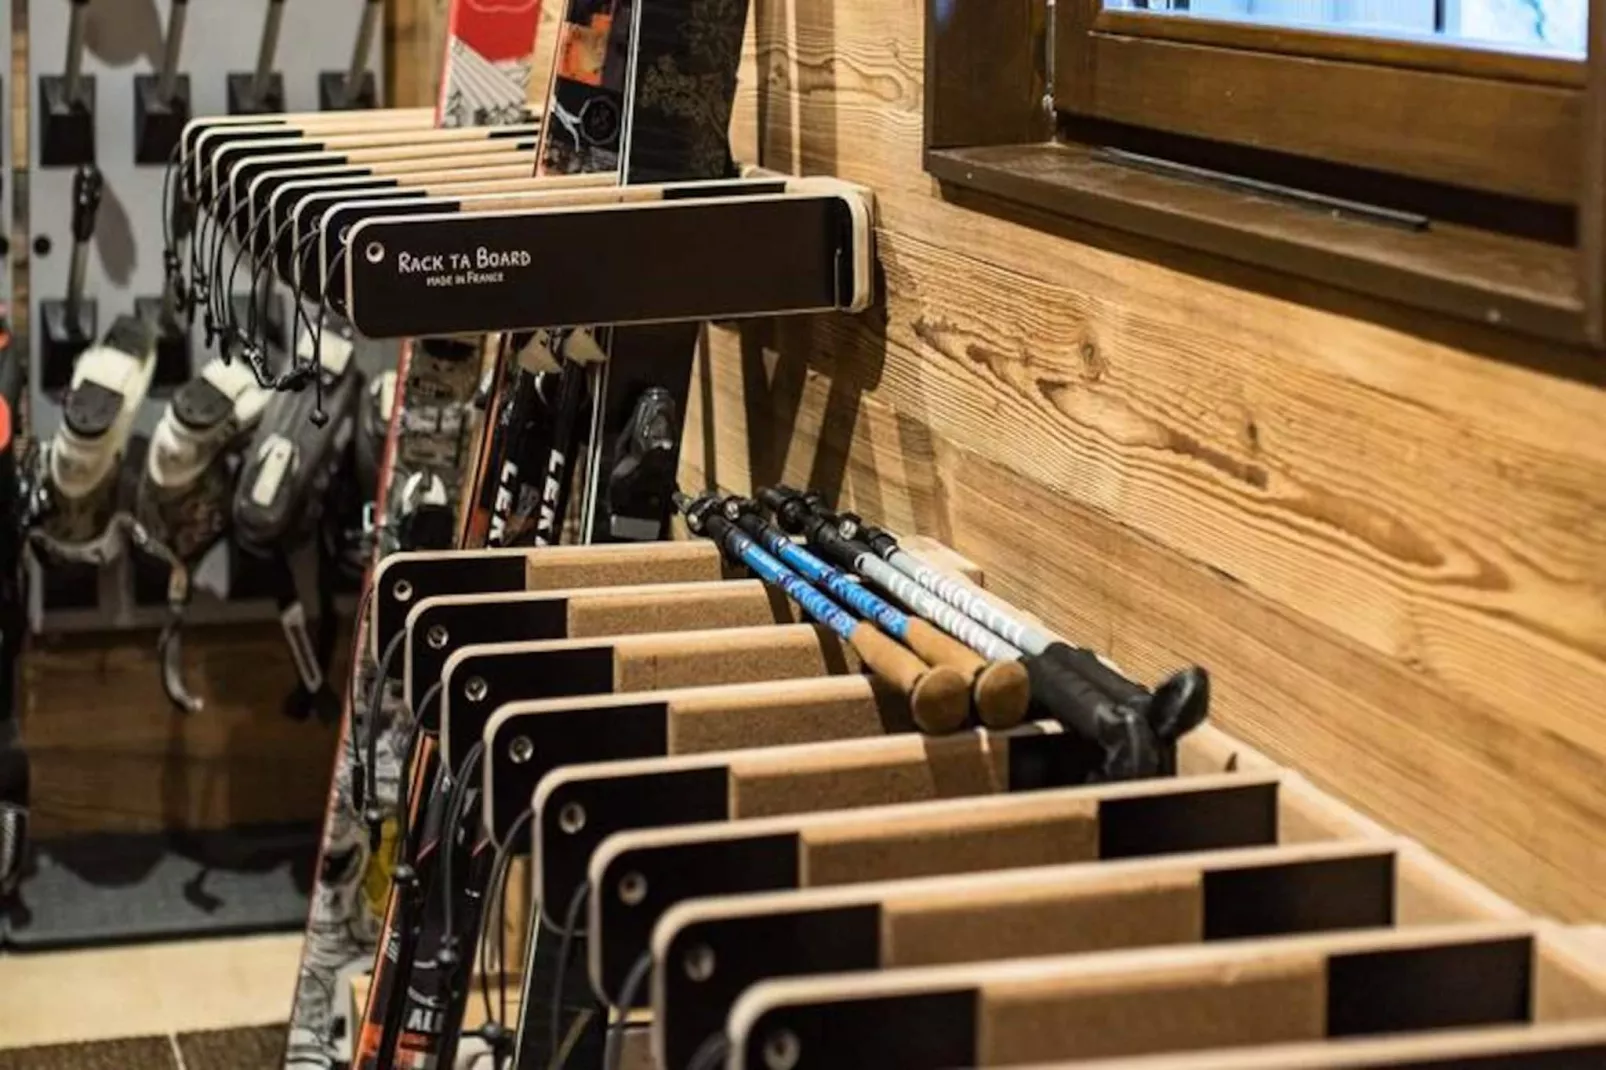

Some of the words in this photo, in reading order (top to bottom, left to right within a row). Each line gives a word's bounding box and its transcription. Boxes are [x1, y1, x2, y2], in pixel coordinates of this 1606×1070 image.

[398, 251, 444, 273] RACK
[449, 253, 471, 269] TA
[476, 246, 532, 269] BOARD
[466, 270, 504, 284] FRANCE
[487, 459, 519, 548] LEK
